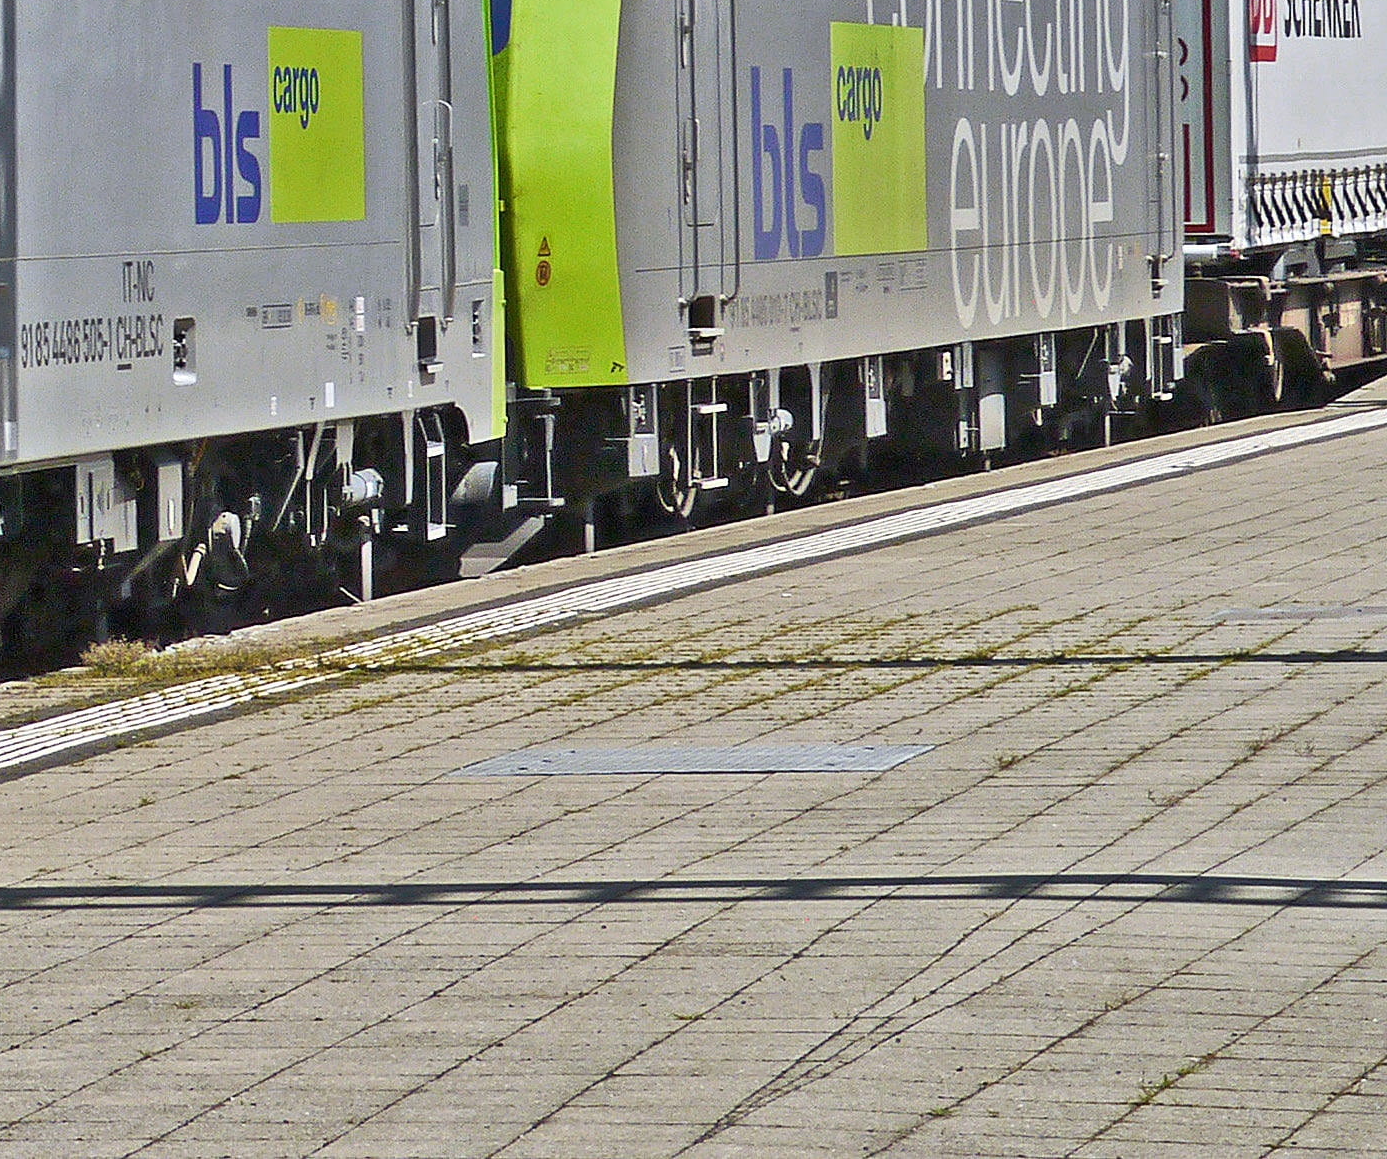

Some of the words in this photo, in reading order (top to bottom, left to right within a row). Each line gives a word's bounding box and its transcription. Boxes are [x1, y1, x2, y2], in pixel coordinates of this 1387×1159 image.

[273, 64, 320, 130] cargo
[836, 65, 884, 141] cargo
[192, 63, 261, 225] bls
[750, 65, 826, 261] bls
[950, 118, 1113, 330] europe
[122, 260, 155, 303] IT-NC
[116, 314, 164, 360] CH-BLSC
